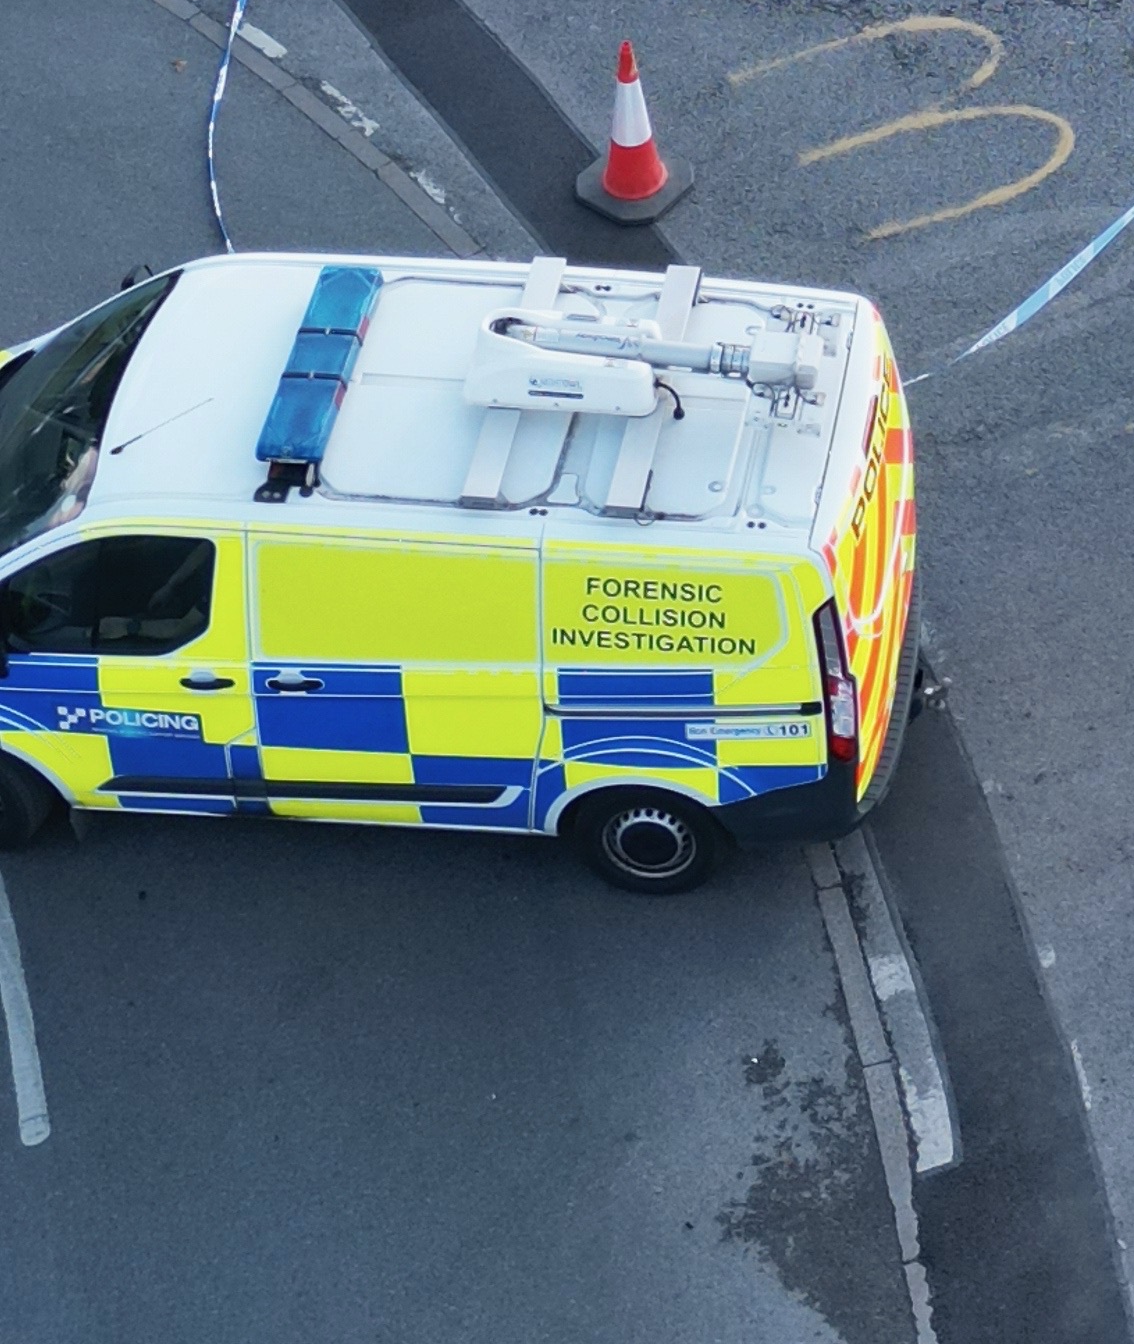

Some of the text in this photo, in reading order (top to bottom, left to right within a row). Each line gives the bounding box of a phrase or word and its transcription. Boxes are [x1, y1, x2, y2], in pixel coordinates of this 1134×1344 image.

[851, 352, 891, 541] POLICE
[586, 577, 723, 603] FORENSIC
[582, 603, 726, 630] COLLISION
[552, 627, 756, 655] INVESTIGATION
[89, 708, 200, 731] POLICING
[779, 723, 809, 736] 101
